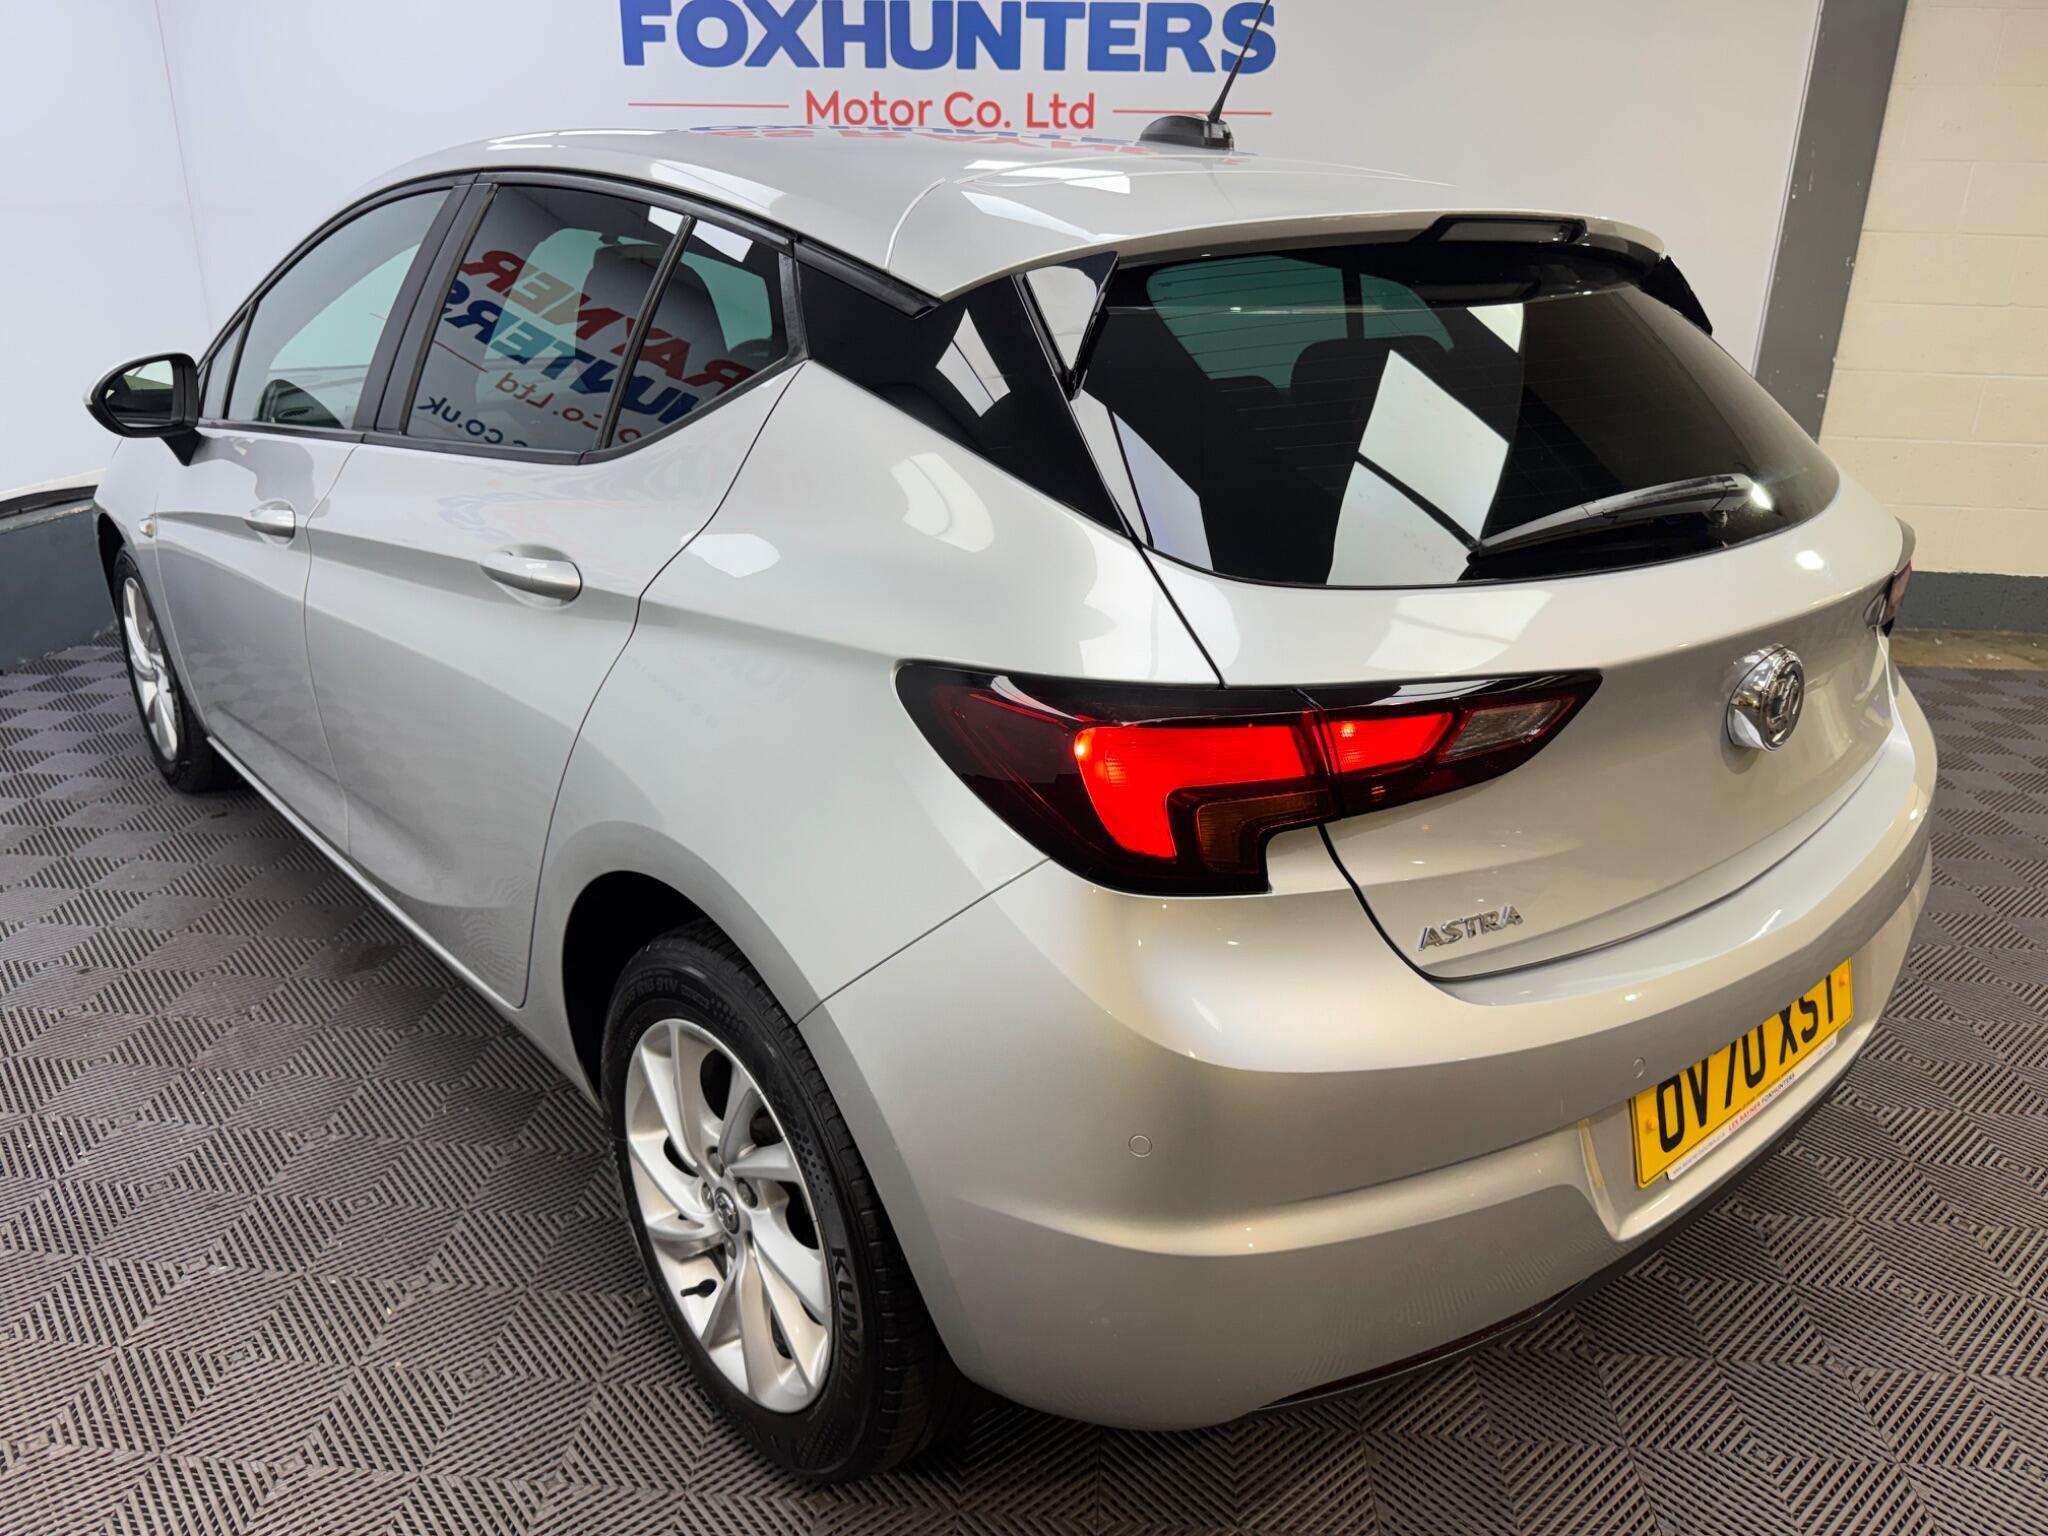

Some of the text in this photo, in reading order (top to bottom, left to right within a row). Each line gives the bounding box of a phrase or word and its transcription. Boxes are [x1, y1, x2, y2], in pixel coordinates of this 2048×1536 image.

[621, 0, 1276, 74] FOXHUNTERS
[805, 90, 1095, 130] Motor Co. Ltd
[1419, 905, 1523, 951] ASTRA
